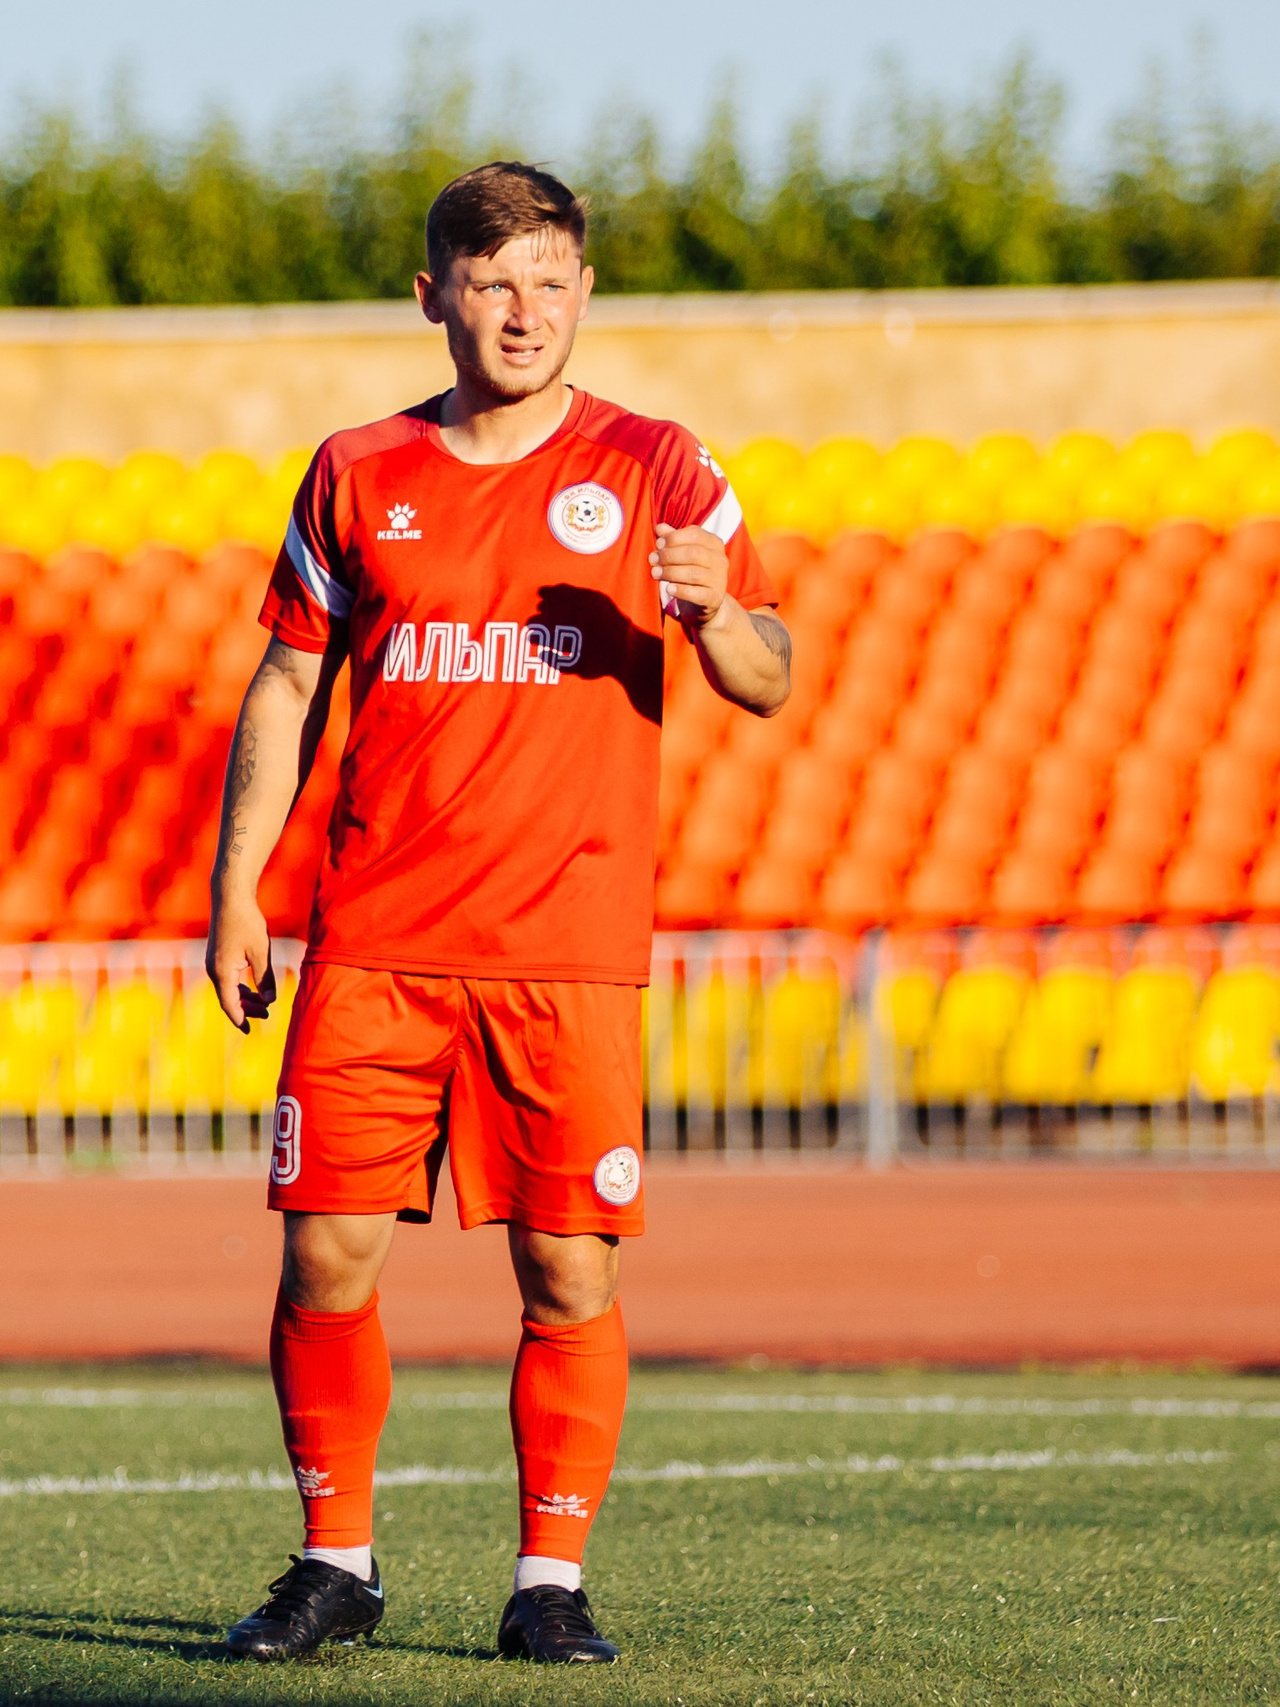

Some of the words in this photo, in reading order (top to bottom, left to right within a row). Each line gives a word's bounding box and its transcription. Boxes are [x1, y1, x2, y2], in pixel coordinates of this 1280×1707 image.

[377, 529, 422, 541] KELME
[383, 622, 582, 685] ИЛЬПАР
[272, 1096, 302, 1185] 9
[536, 1504, 588, 1518] KELME
